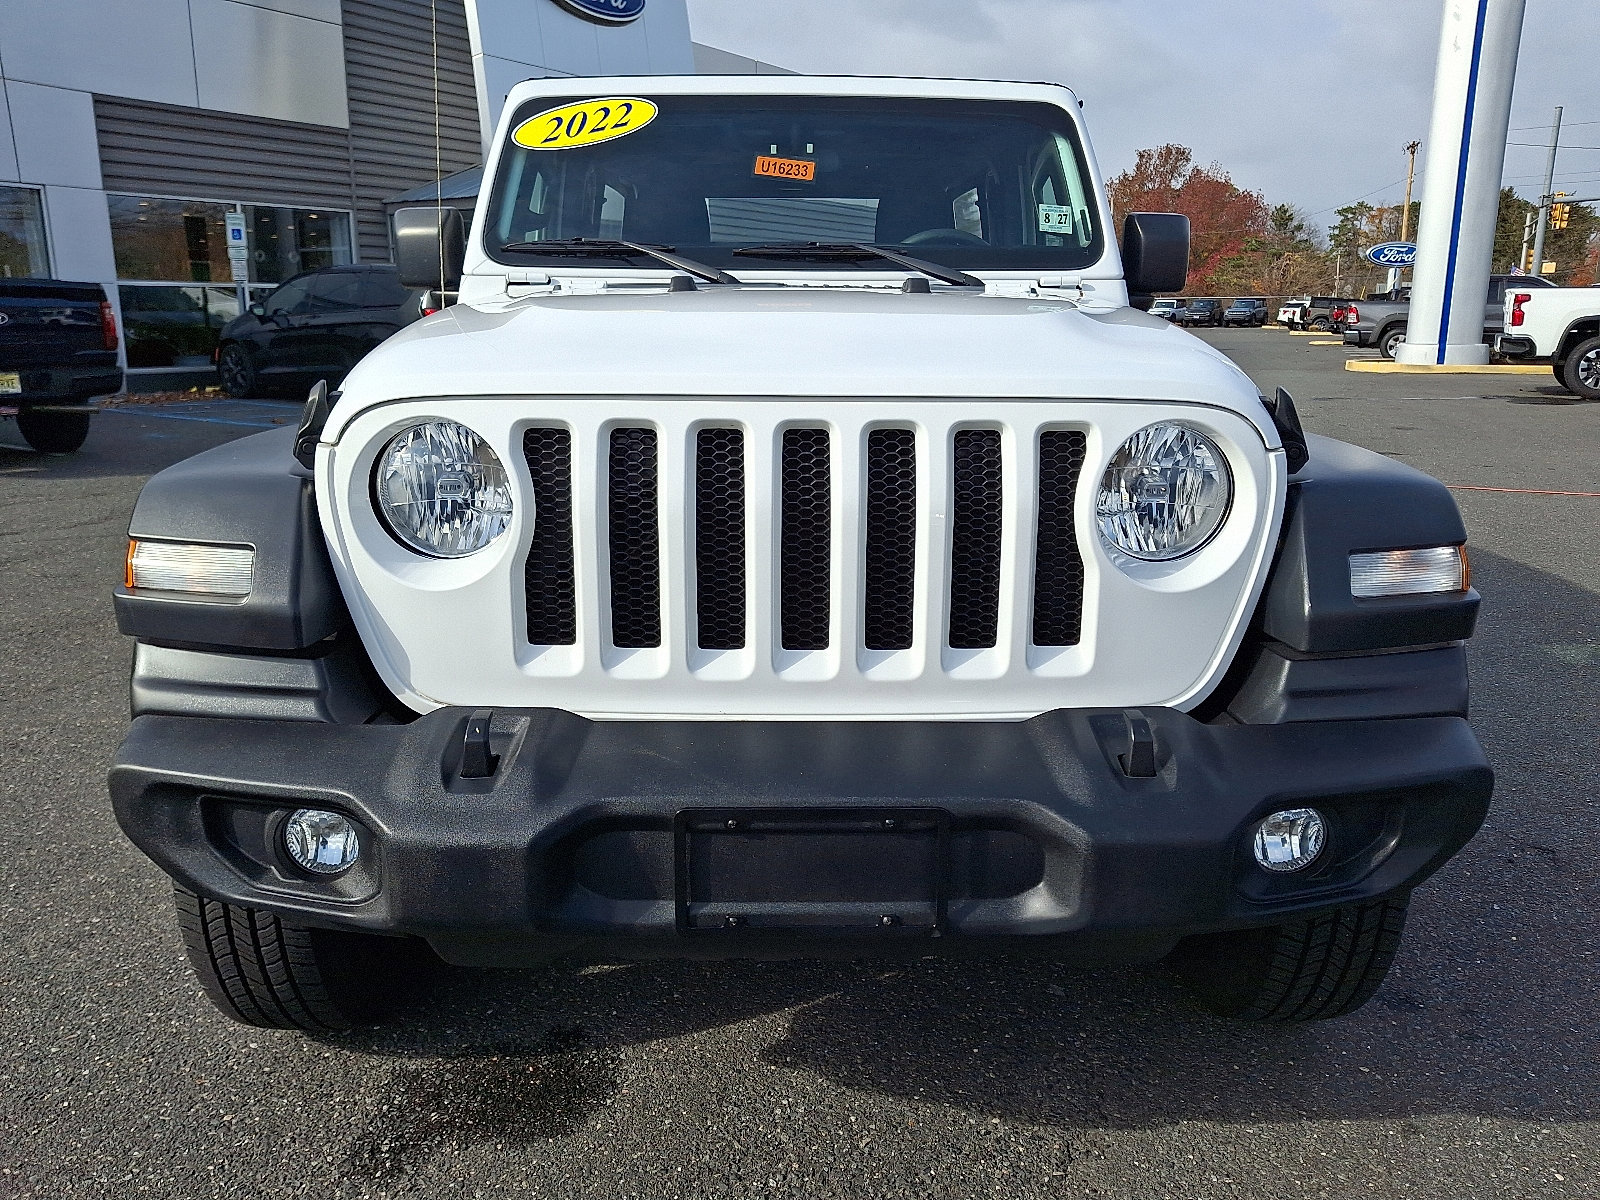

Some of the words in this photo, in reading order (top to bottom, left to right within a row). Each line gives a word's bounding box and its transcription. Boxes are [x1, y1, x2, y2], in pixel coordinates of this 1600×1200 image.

[540, 102, 633, 144] 2022
[761, 160, 809, 177] U16233
[1043, 212, 1051, 224] 8
[1057, 213, 1068, 225] 27
[1380, 246, 1417, 262] Ford
